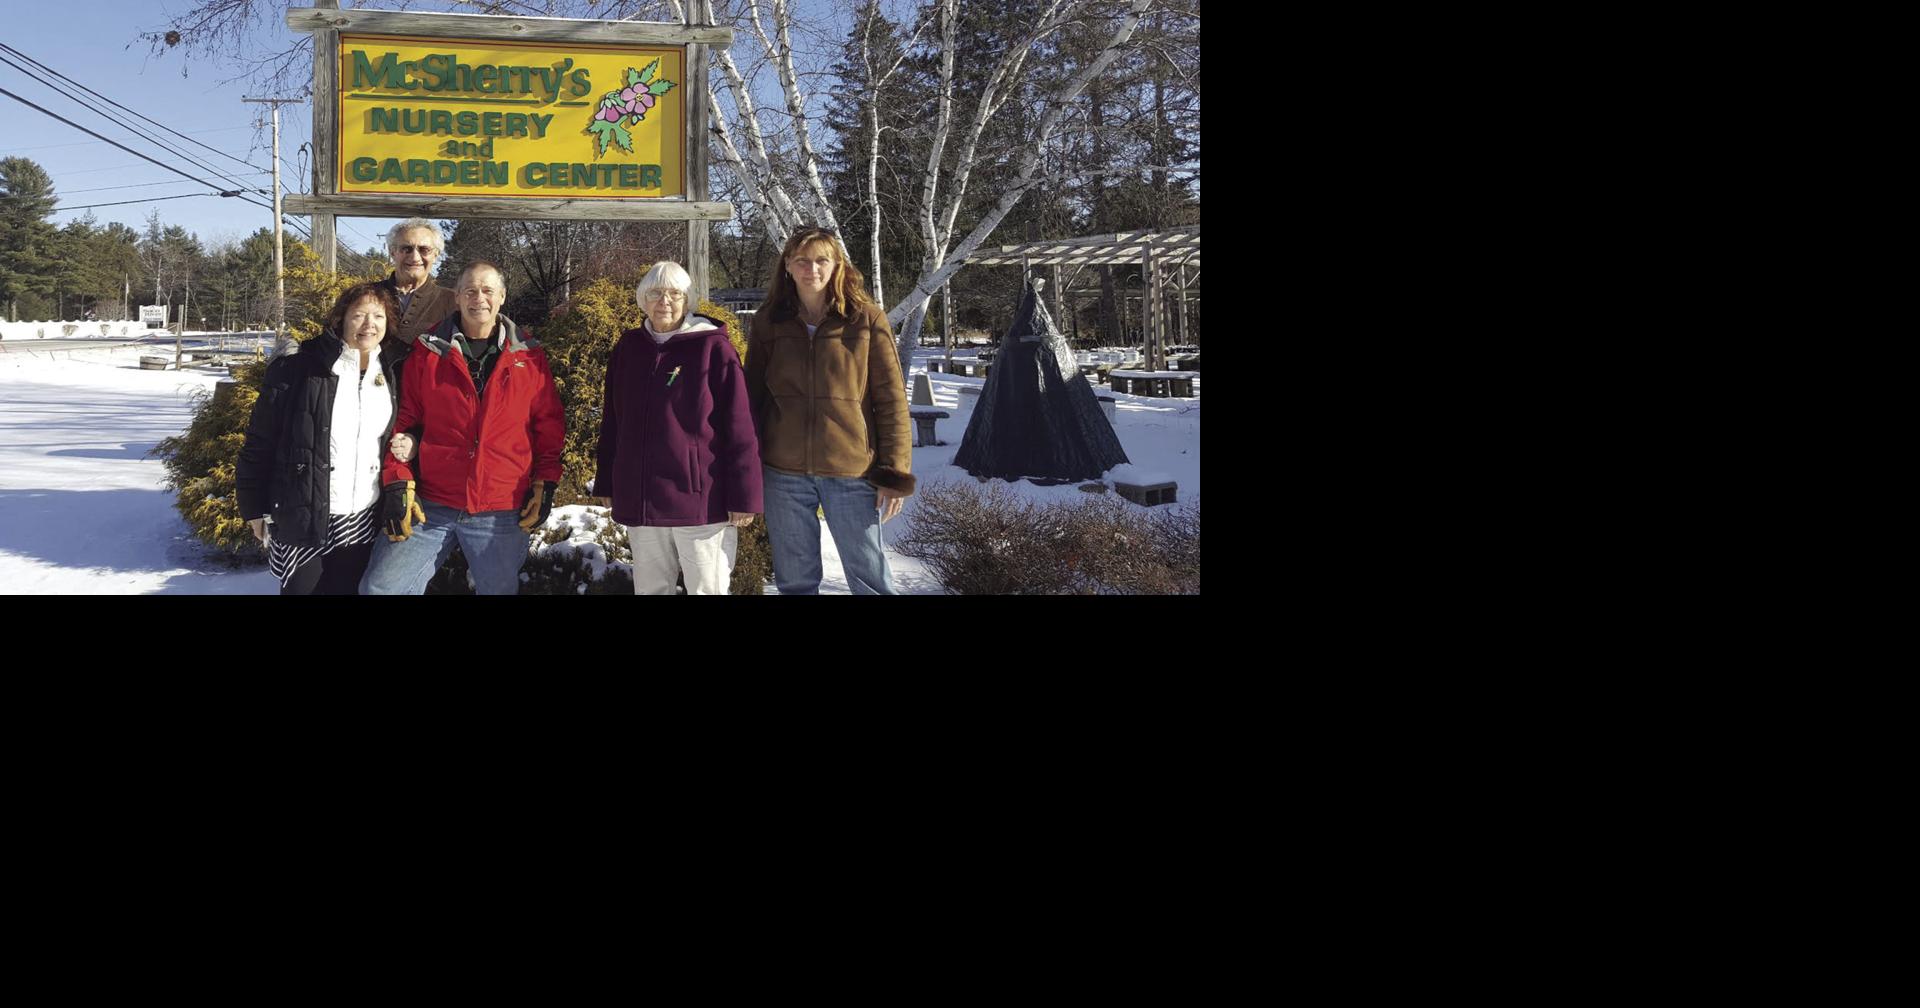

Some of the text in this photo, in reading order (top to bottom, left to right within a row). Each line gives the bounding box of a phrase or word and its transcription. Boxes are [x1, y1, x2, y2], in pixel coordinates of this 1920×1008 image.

[351, 50, 591, 101] McSherry's
[371, 108, 553, 138] NURSERY
[446, 136, 493, 160] and
[353, 157, 662, 188] GARDEN CENTER
